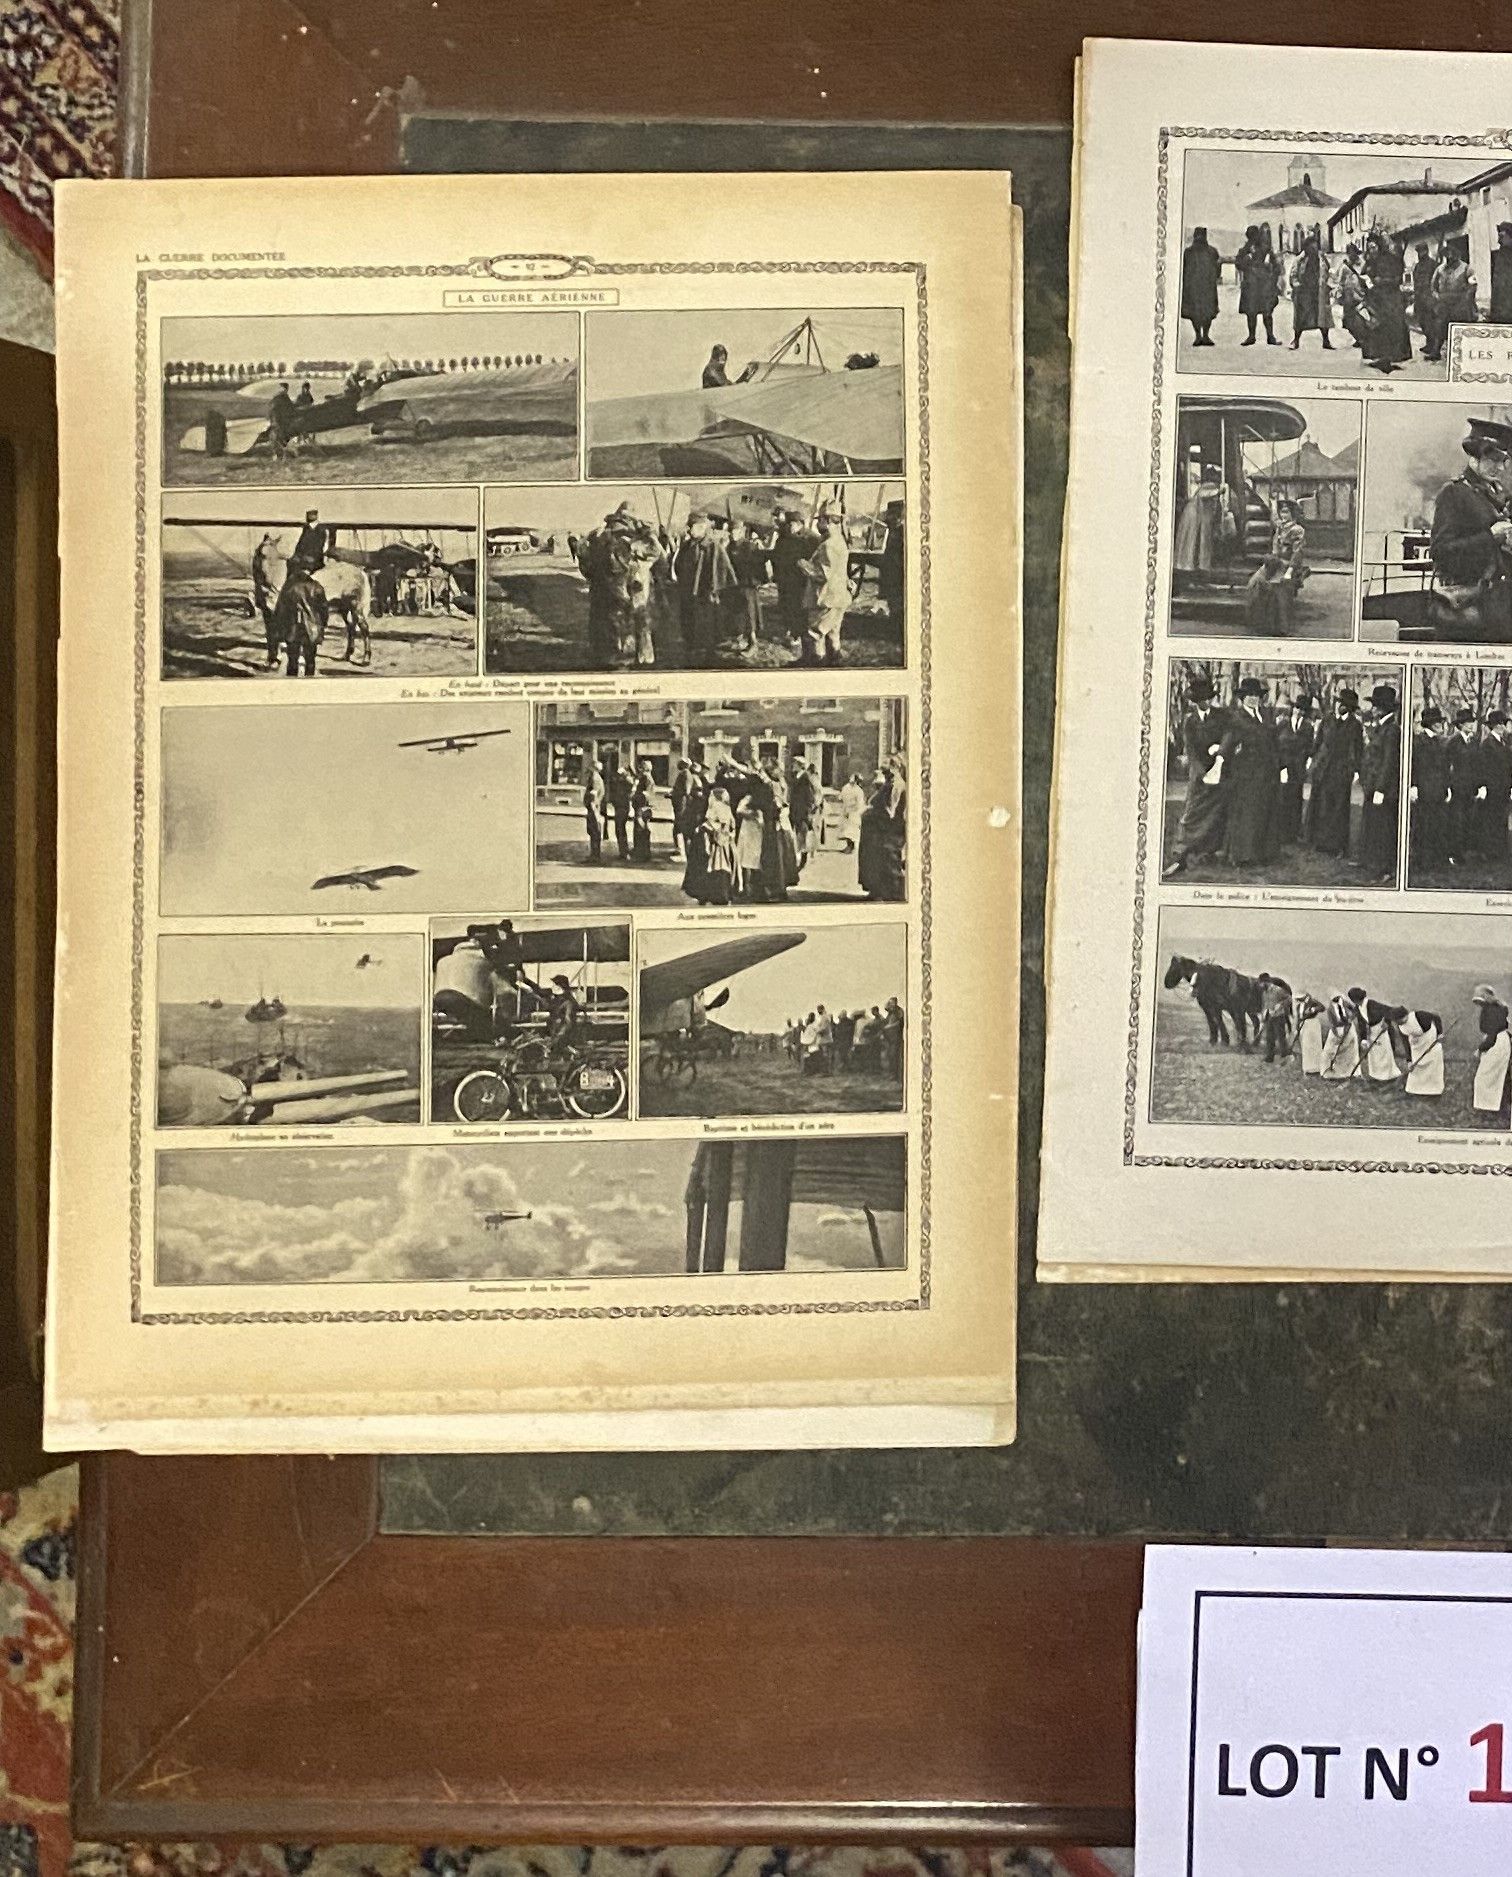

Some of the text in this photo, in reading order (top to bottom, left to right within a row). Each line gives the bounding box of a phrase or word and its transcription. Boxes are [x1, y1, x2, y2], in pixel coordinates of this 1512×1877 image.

[136, 253, 151, 263] LA
[159, 253, 205, 262] GUERRE
[458, 291, 606, 303] LA GUERRE AÉRIENNE
[1468, 350, 1494, 360] LES
[1217, 1743, 1341, 1800] LOT
[1365, 1744, 1439, 1801] N°
